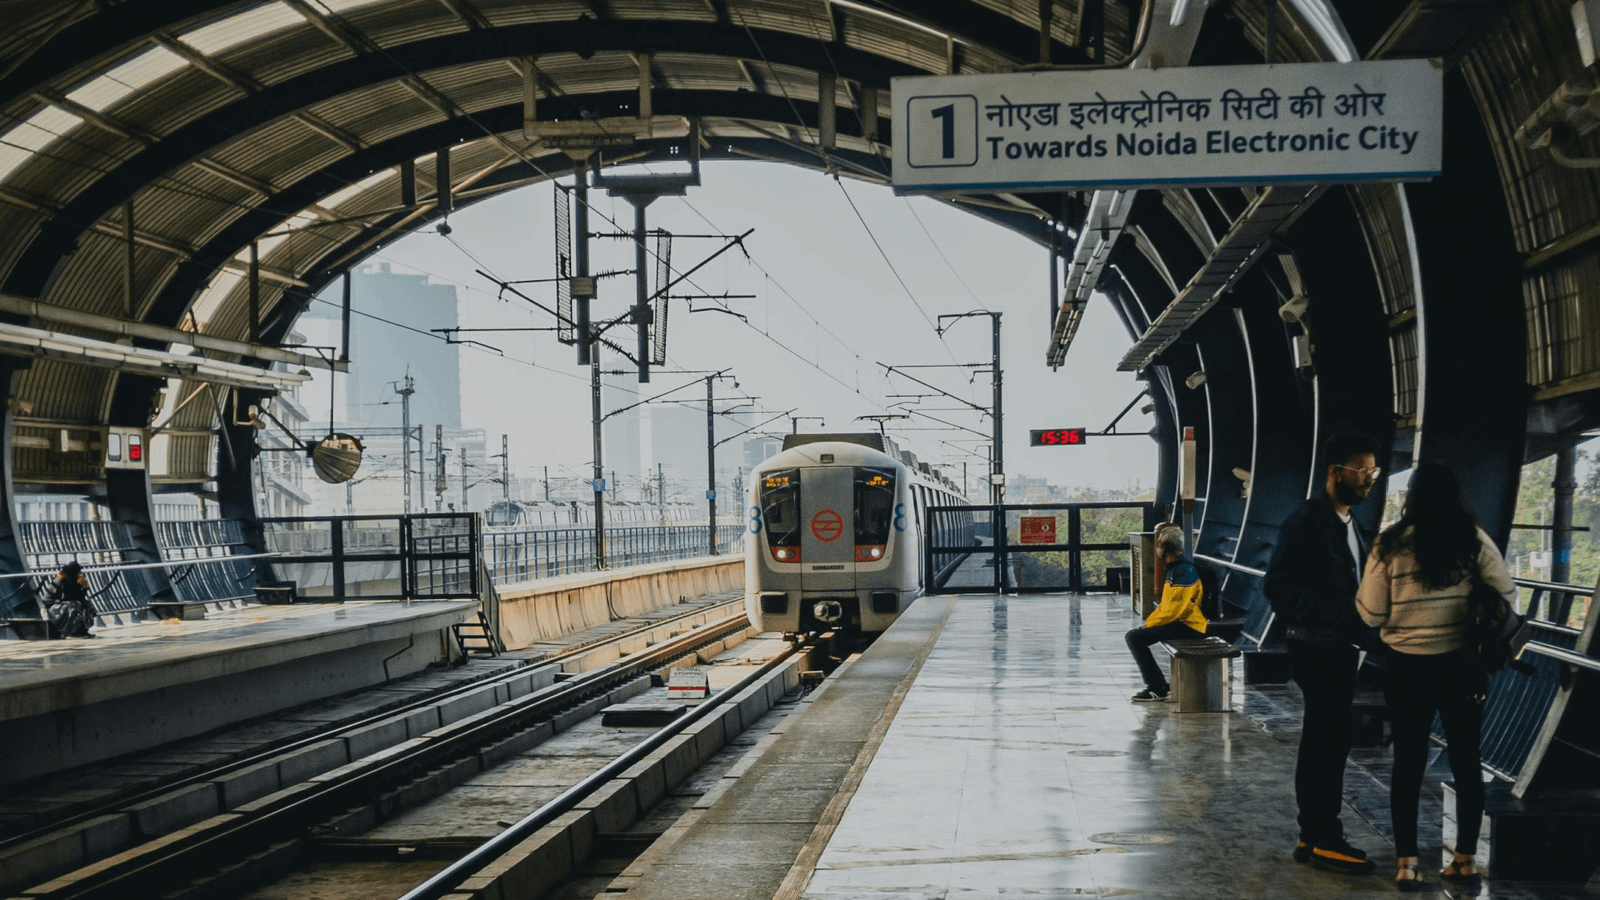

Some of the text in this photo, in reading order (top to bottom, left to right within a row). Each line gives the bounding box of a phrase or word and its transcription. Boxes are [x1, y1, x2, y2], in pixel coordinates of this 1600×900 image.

[985, 94, 1061, 131] नोएडा
[1220, 87, 1281, 121] सिटी
[1288, 86, 1326, 119] की
[1334, 83, 1387, 117] ओर
[931, 103, 955, 159] 1
[986, 124, 1420, 159] Towards Noida Electronic City
[1041, 429, 1080, 445] 15:36
[750, 505, 763, 535] 8
